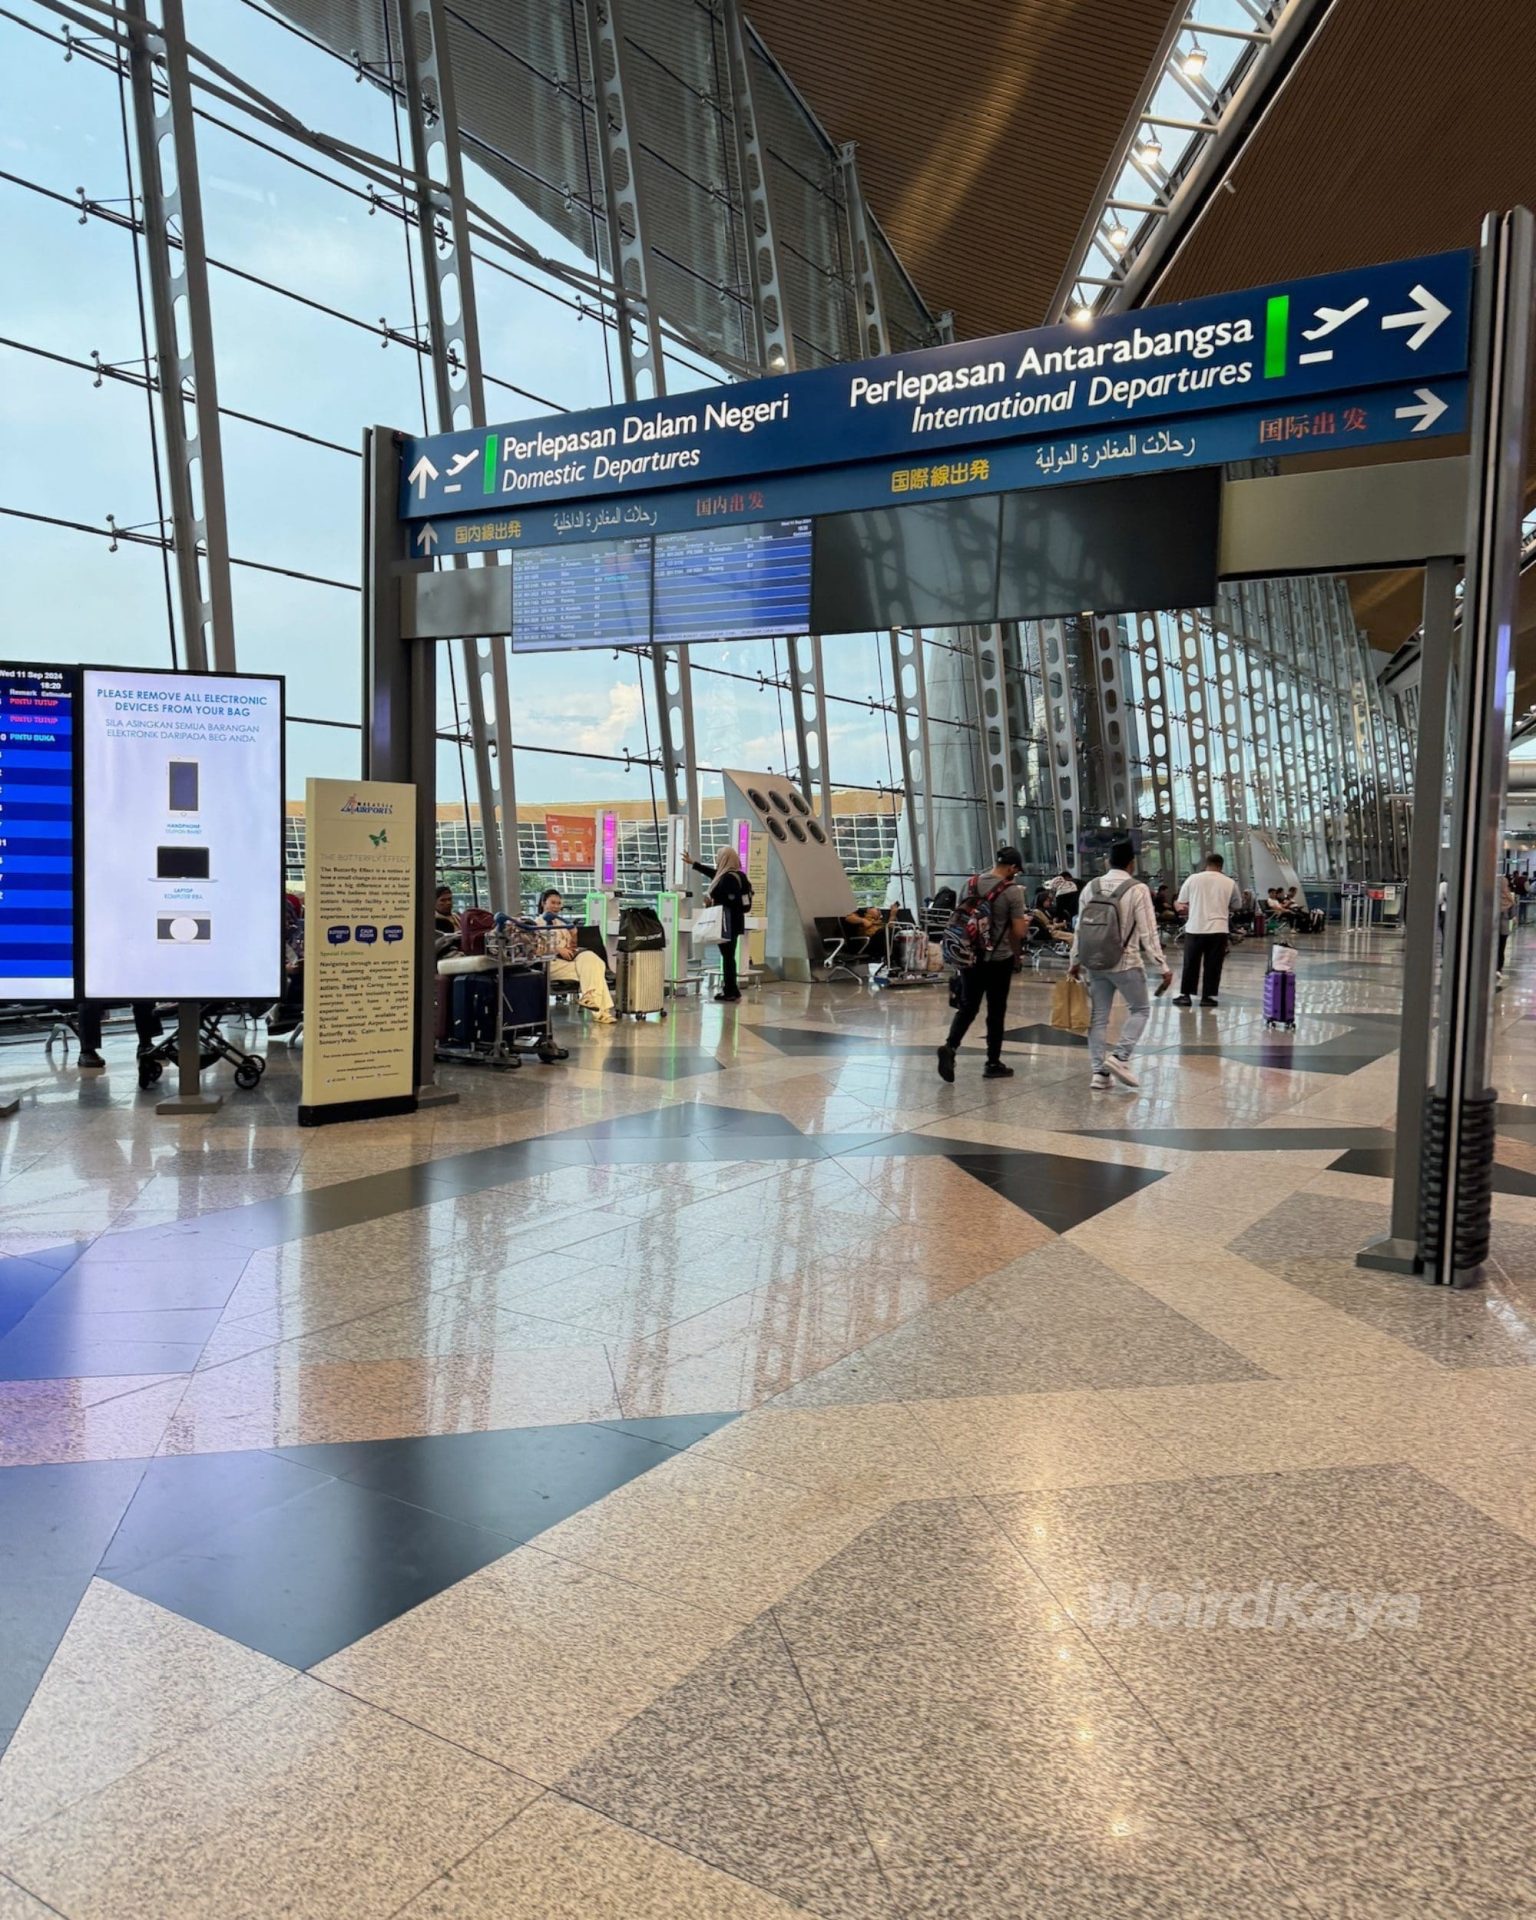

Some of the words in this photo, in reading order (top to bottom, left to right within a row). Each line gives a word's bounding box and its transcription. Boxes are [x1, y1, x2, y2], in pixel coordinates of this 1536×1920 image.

[850, 361, 1005, 407] Perlepasan
[1015, 318, 1254, 379] Antarabangsa
[912, 380, 1076, 433] International
[1088, 361, 1252, 408] Departures
[503, 427, 616, 461] Perlepasan
[623, 412, 697, 444] Dalam
[704, 393, 789, 432] Negeri
[1260, 407, 1367, 443] 国际出发
[1081, 434, 1136, 468] المغادرة
[1142, 430, 1195, 456] رحلات
[502, 461, 586, 492] Domestic
[593, 449, 700, 483] Departures
[1035, 443, 1077, 474] الدولية
[891, 458, 989, 492] 国際線出発
[624, 505, 657, 526] رحلات
[696, 491, 764, 516] 国内出发
[455, 520, 521, 544] 国内線出発
[586, 507, 620, 532] المغادرة
[17, 670, 26, 678] 11
[27, 671, 43, 680] Sep
[44, 672, 63, 680] 2024
[97, 688, 134, 700] PLEASE
[136, 690, 181, 701] REMOVE
[183, 693, 201, 702] ALL
[204, 694, 268, 706] ELECTRONIC
[115, 701, 159, 713] DEVICES
[162, 704, 193, 714] FROM
[195, 705, 224, 716] YOUR
[227, 708, 251, 717] BAG
[105, 718, 124, 727] SILA
[125, 720, 173, 729] ASINGKAN
[175, 722, 206, 731] SEMUA
[207, 723, 260, 733] BARANGAN
[106, 728, 158, 739] ELEKTRONIK
[160, 730, 206, 741] DARIPADA
[208, 732, 227, 742] BEG
[355, 806, 393, 814] AIRPORTS
